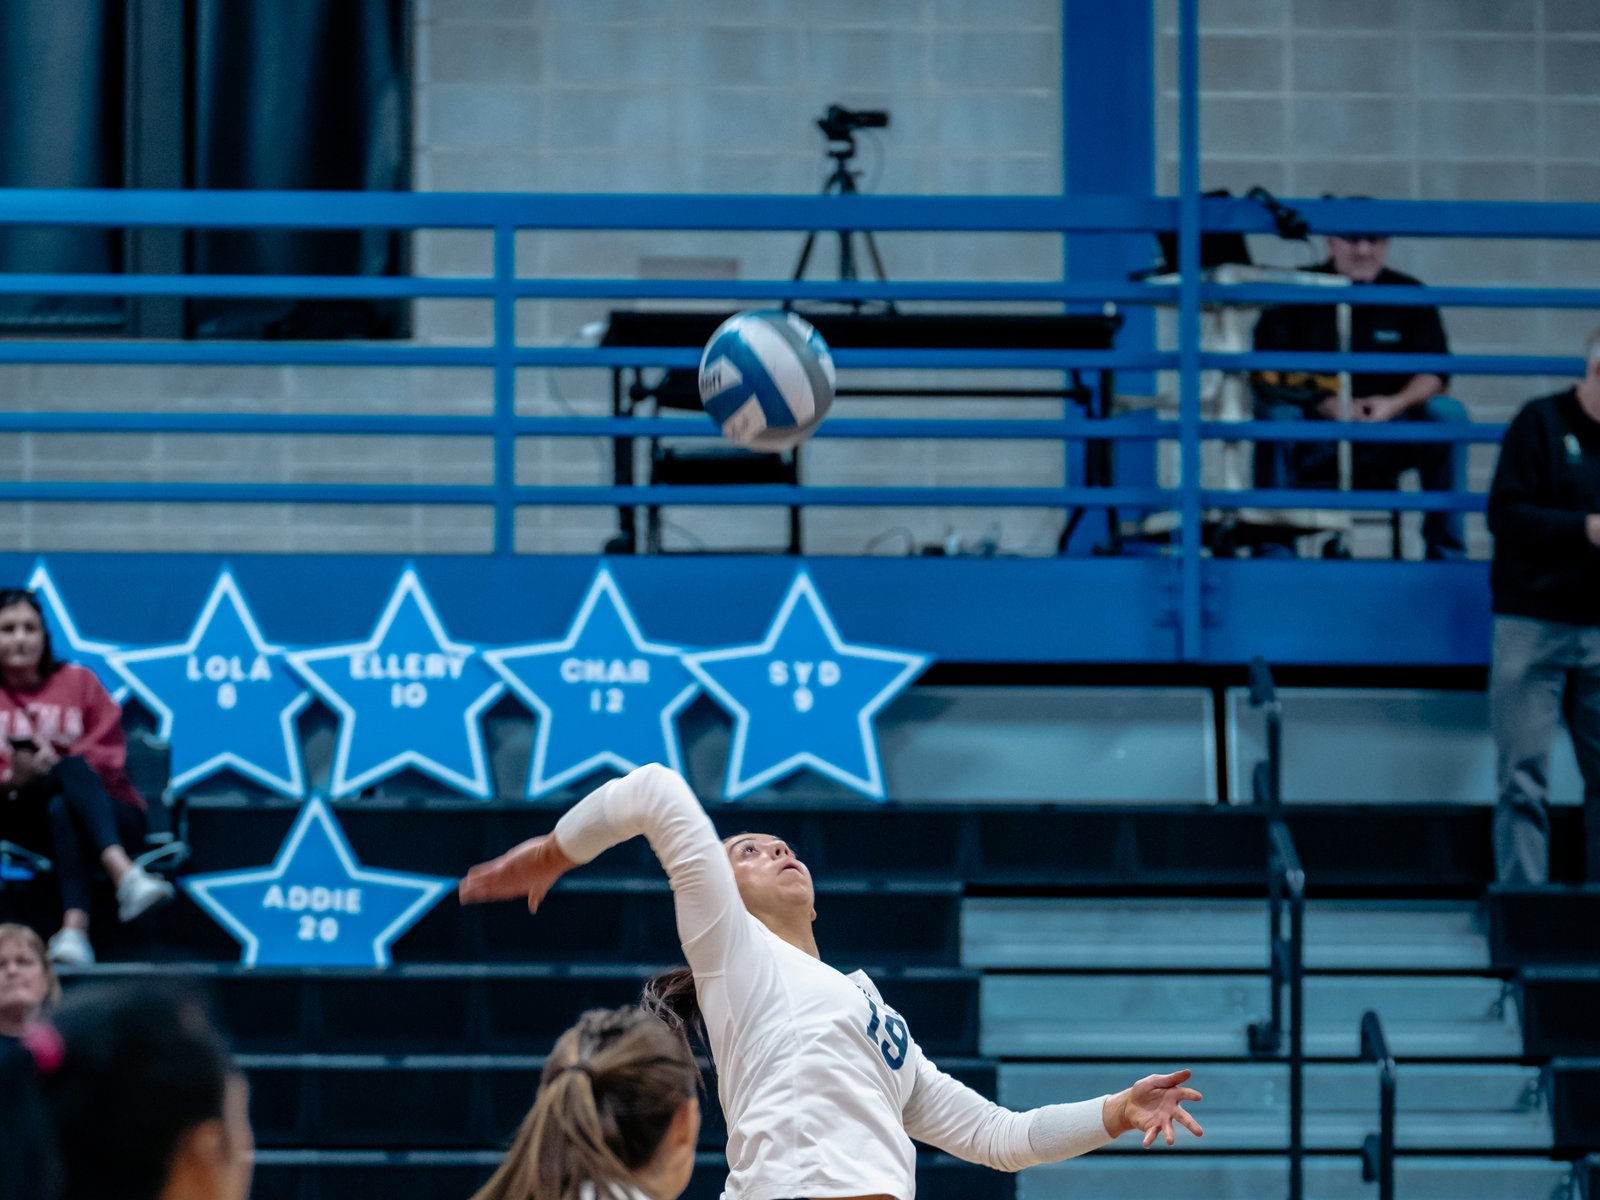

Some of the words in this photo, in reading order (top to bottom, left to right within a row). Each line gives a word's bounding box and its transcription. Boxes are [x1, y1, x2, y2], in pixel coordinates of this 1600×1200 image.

[187, 655, 272, 681] LOLA
[350, 653, 466, 680] ELLERY
[561, 658, 650, 683] CHAR
[768, 660, 841, 686] SYD
[391, 682, 427, 708] 10
[590, 688, 624, 712] 12
[262, 884, 362, 914] ADDIE
[298, 915, 339, 942] 20
[865, 996, 908, 1070] 19
